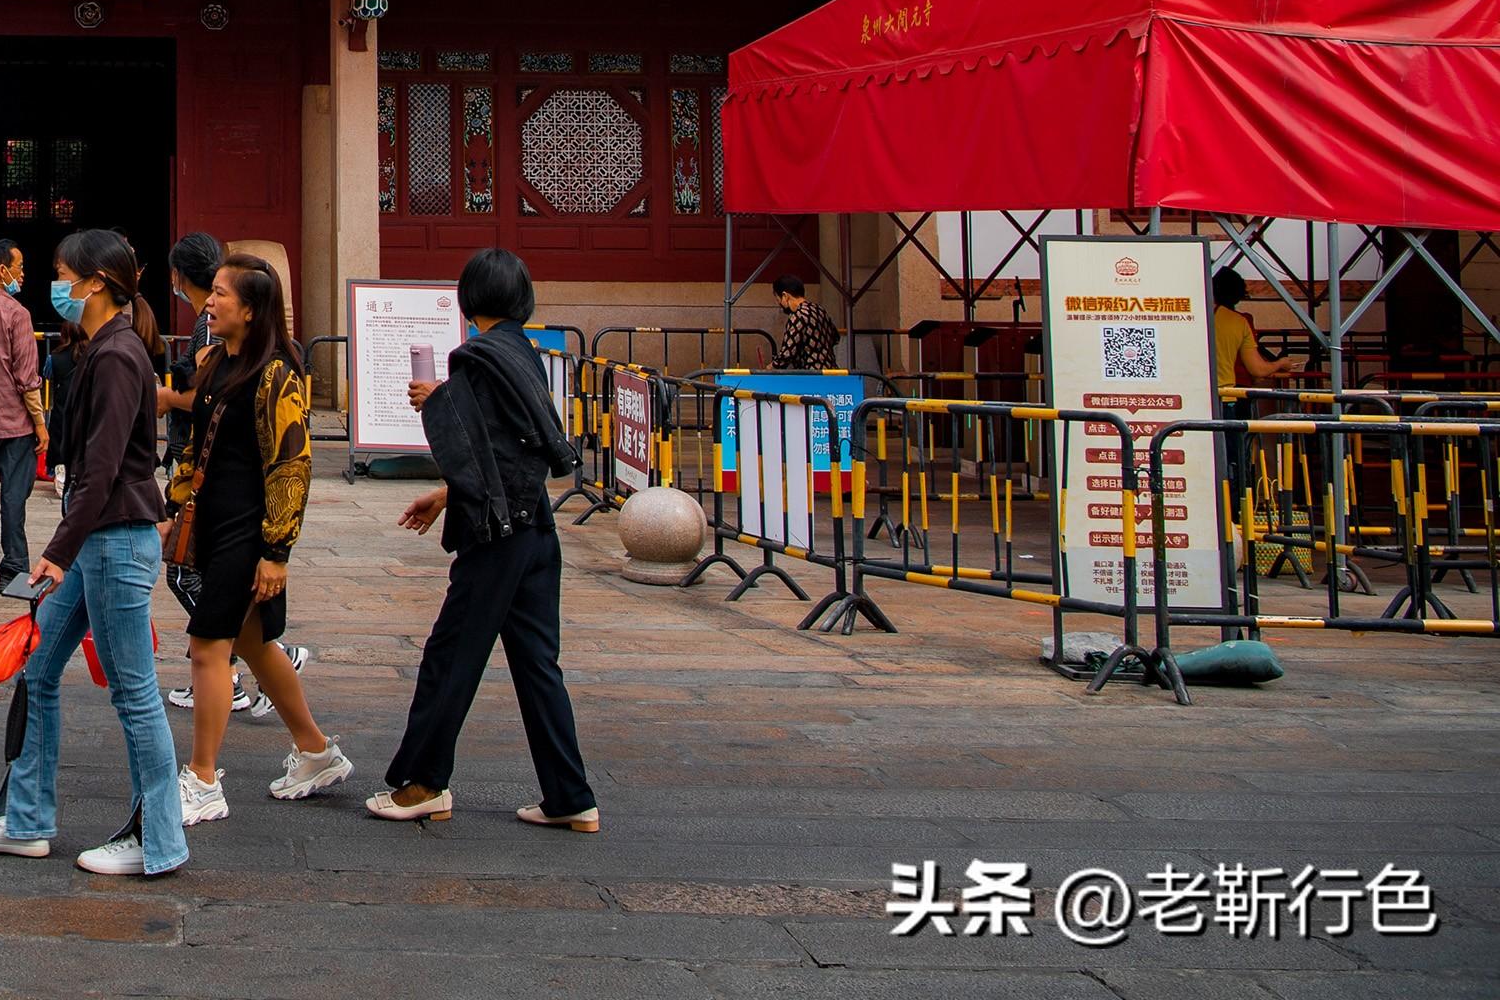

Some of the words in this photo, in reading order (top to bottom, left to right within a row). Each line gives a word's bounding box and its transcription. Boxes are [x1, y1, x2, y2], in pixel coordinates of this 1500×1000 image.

[1065, 296, 1191, 312] 微信预约入寺流程
[617, 385, 646, 424] 有序排队
[1091, 396, 1174, 407] 微信扫码关注公众号
[618, 421, 646, 463] 人距1米
